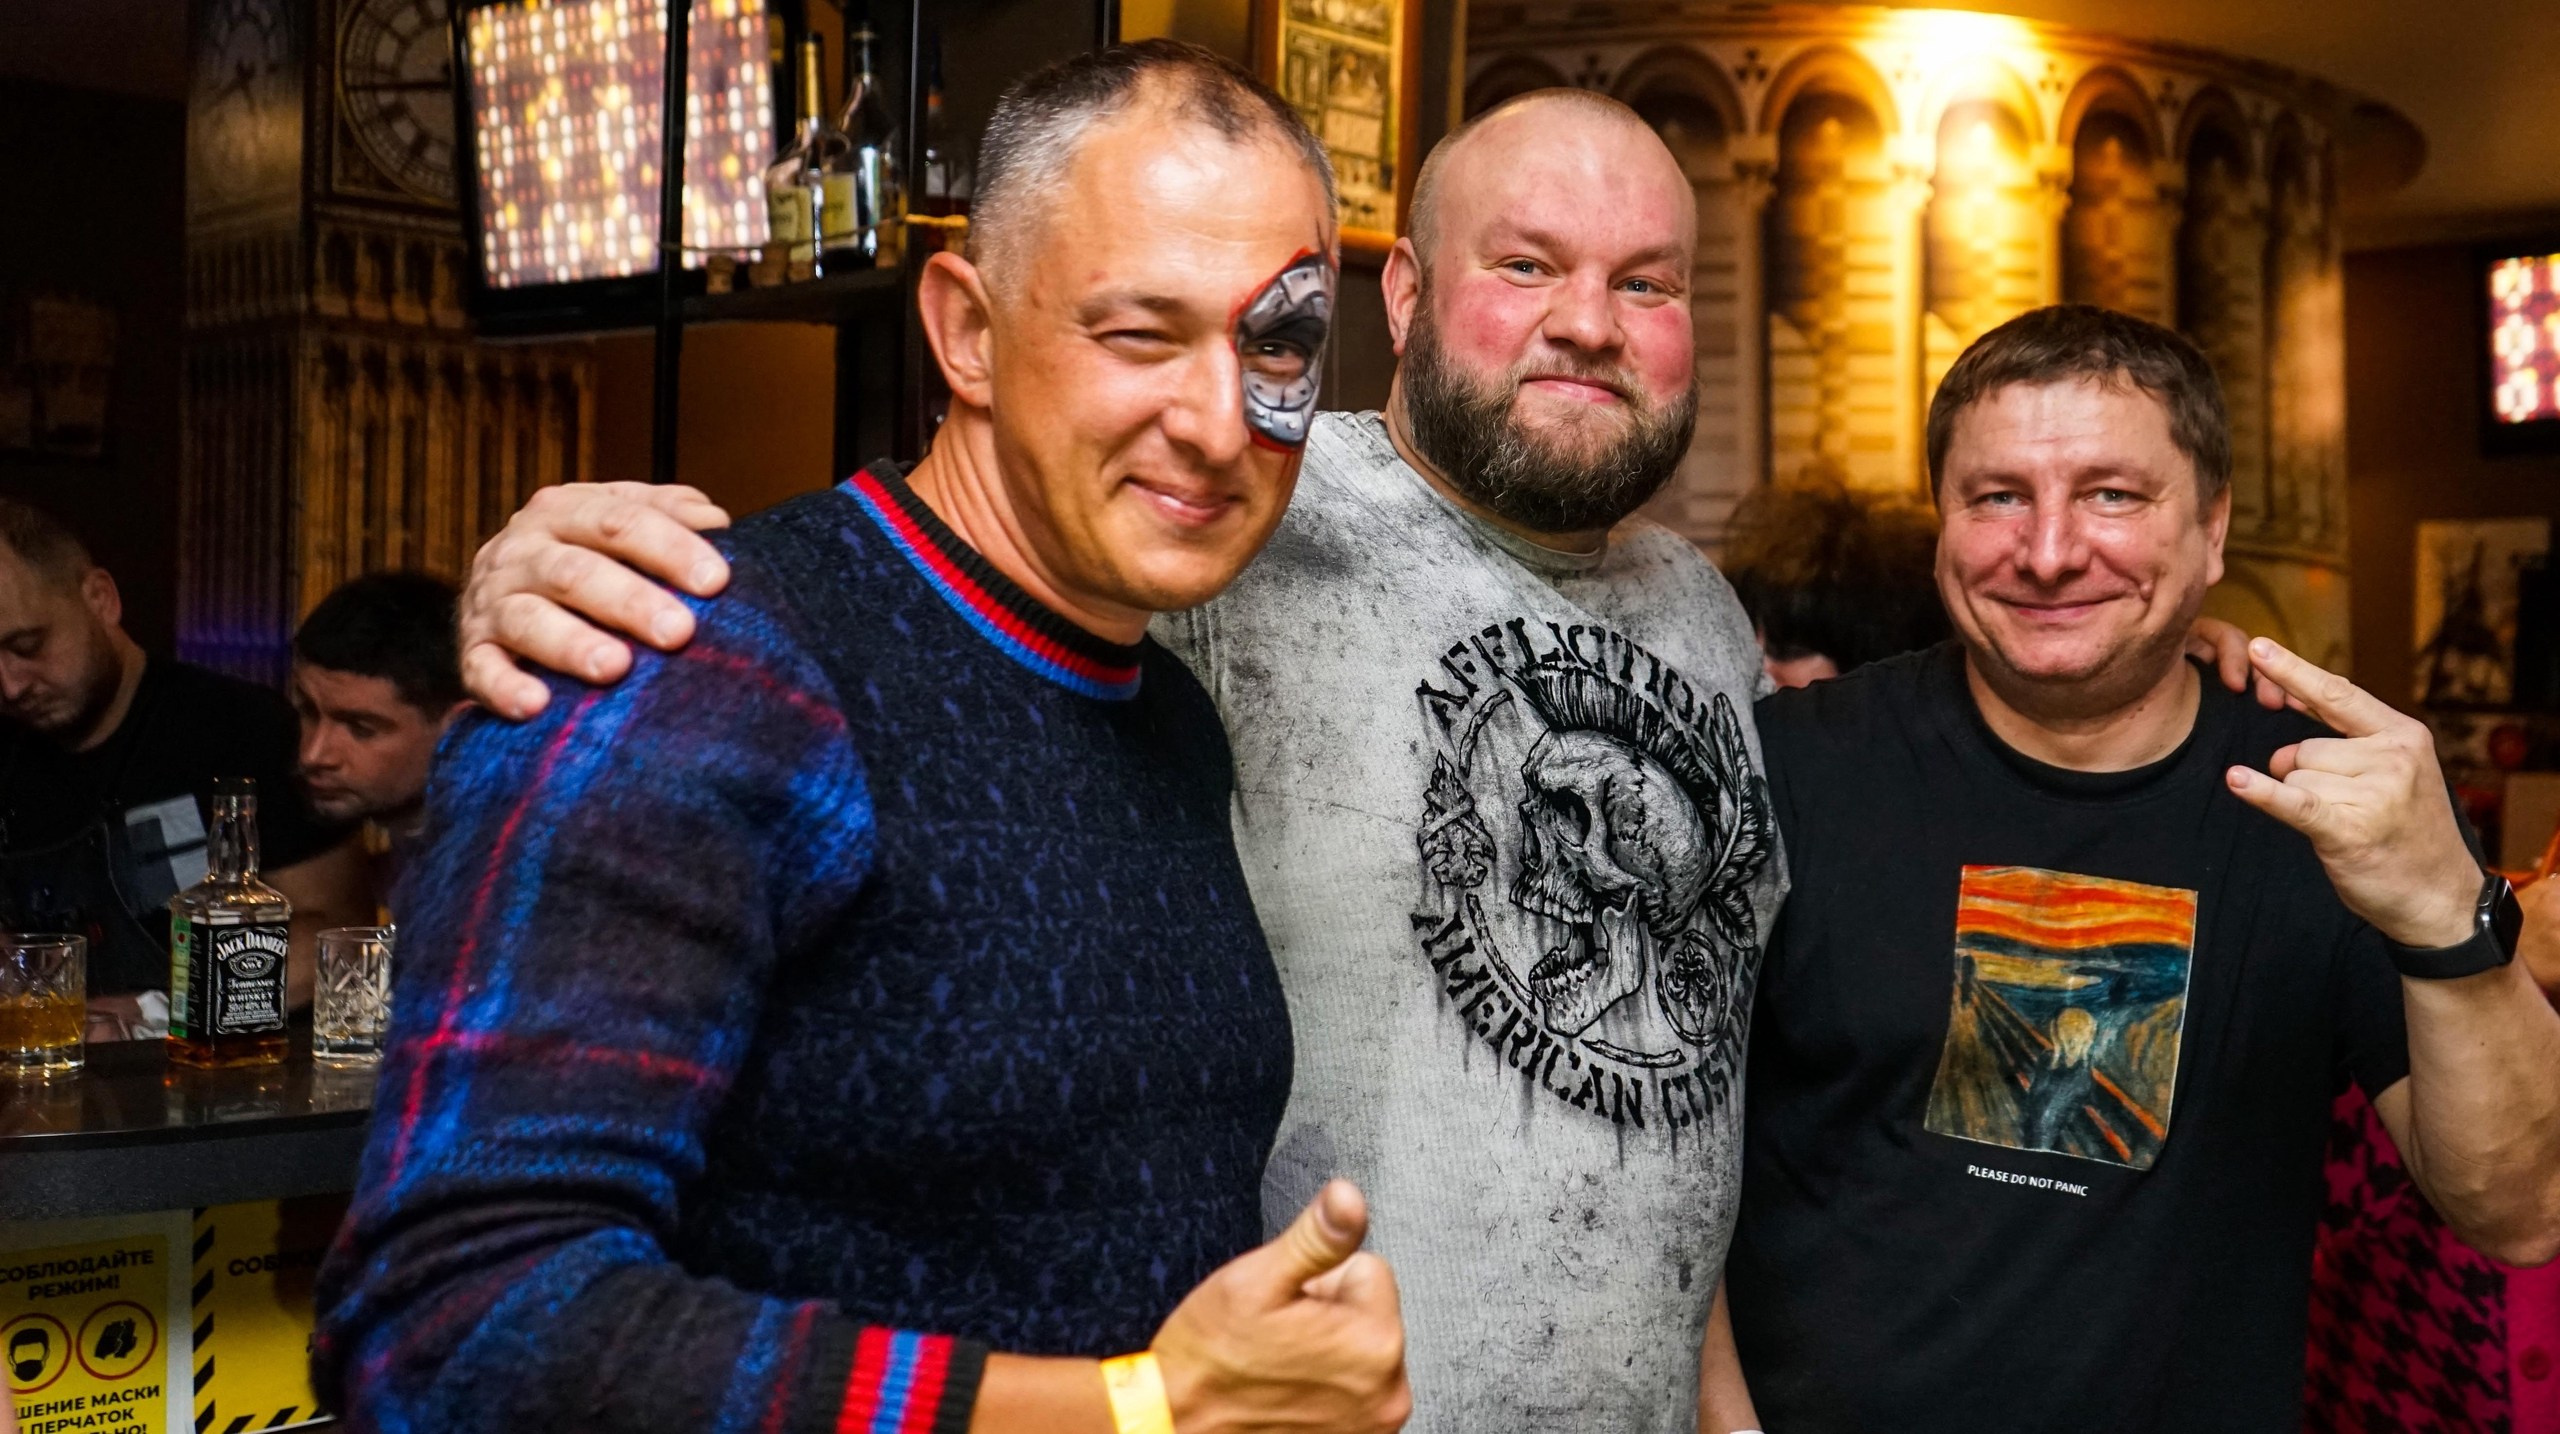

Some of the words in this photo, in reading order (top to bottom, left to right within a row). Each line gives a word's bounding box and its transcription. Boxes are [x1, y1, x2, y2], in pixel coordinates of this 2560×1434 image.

[216, 936, 246, 961] JACK
[228, 992, 274, 1003] WHISKEY
[1410, 911, 1645, 1128] AMERICAN
[1967, 1164, 2008, 1182] PLEASE
[2011, 1174, 2027, 1185] DO
[2029, 1176, 2053, 1189] NOT
[2055, 1180, 2089, 1197] PANIC
[28, 1274, 120, 1300] РЕЖИМ!
[91, 1385, 160, 1408] МАСКИ
[31, 1408, 134, 1434] ПЕРЧАТОК
